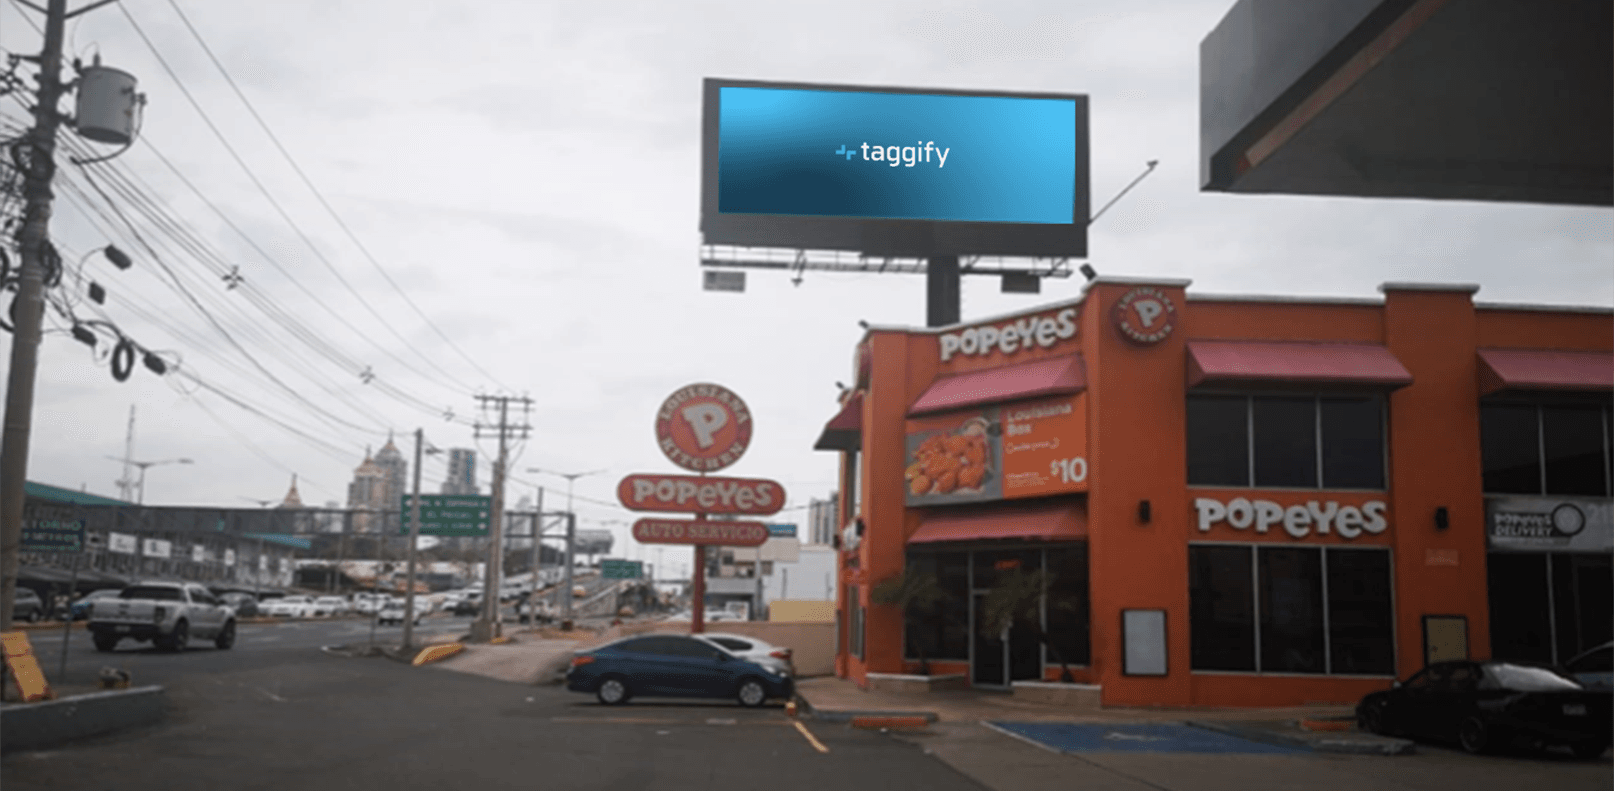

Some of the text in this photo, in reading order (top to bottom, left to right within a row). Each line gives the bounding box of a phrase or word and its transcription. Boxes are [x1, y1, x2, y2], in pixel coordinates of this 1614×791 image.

[860, 140, 951, 168] taggify
[1133, 299, 1163, 328] P
[660, 385, 749, 423] LOUISIANA
[682, 402, 728, 448] P
[660, 437, 743, 469] KITCHEN
[1049, 456, 1088, 485] $10
[638, 523, 765, 542] AUTO SERVICIO
